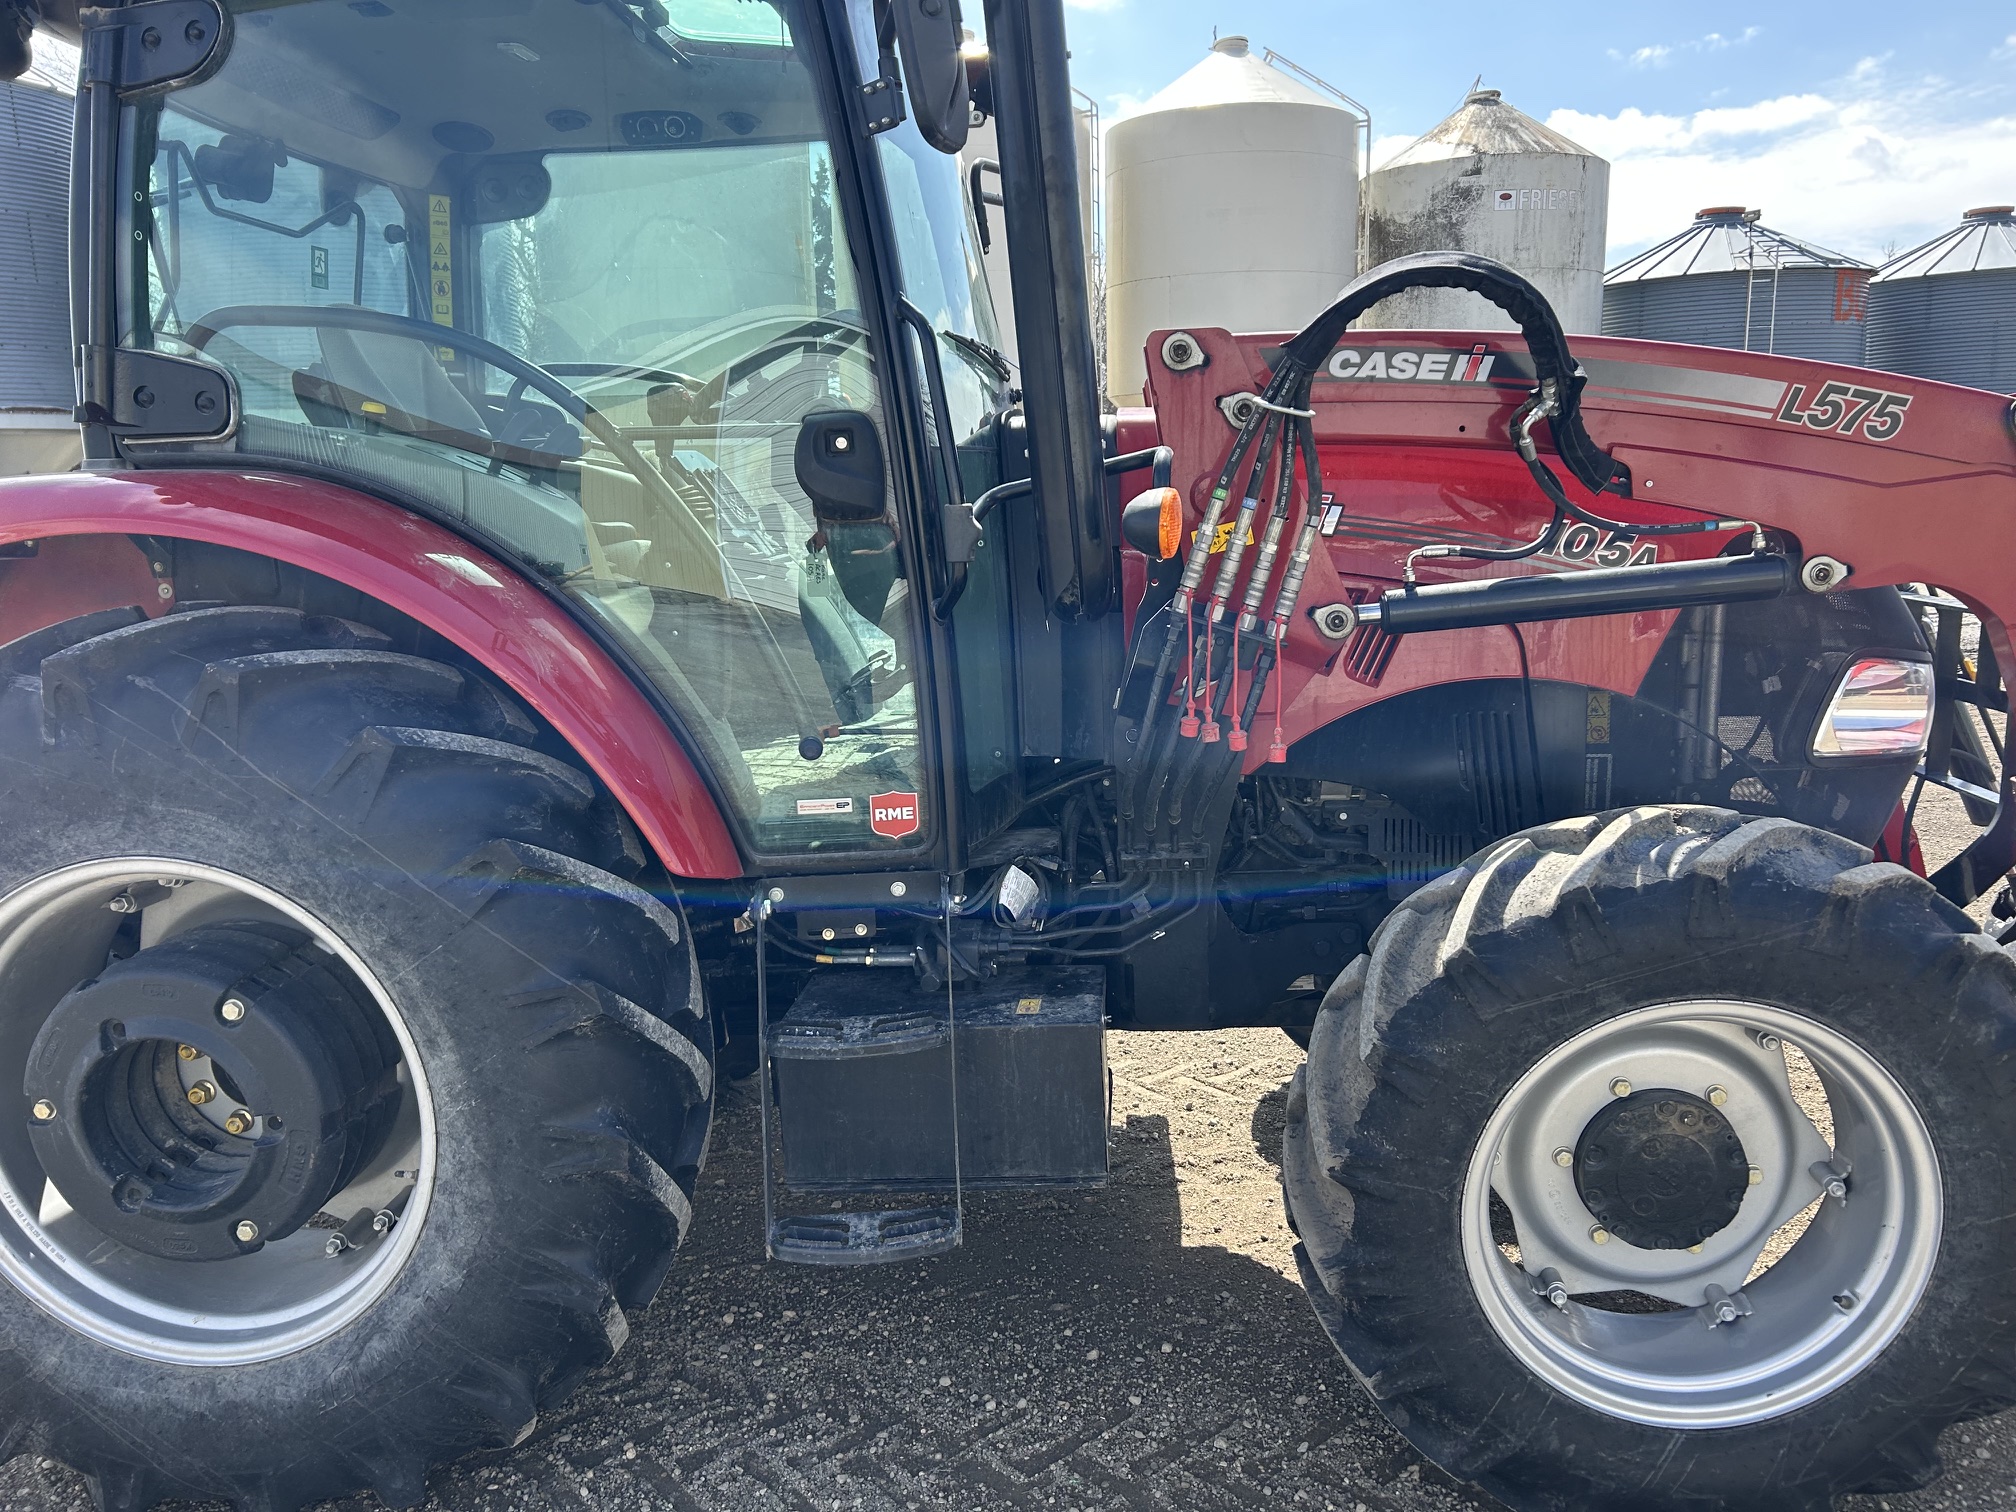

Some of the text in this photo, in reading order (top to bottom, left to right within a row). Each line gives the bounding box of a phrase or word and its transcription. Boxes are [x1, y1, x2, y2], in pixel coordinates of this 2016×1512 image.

[1328, 349, 1451, 381] CASE
[1776, 380, 1914, 442] L575
[874, 806, 915, 822] RME
